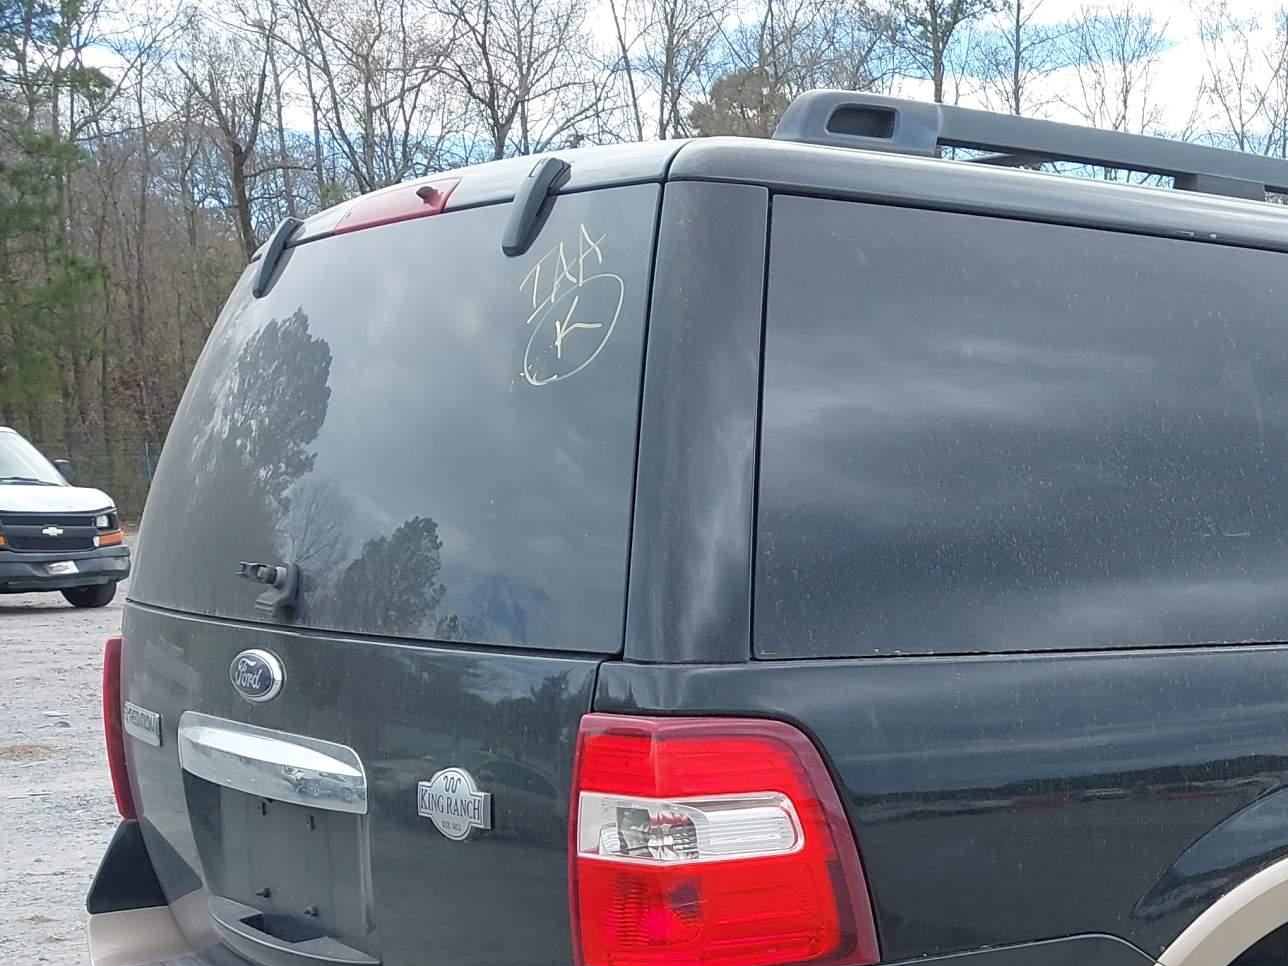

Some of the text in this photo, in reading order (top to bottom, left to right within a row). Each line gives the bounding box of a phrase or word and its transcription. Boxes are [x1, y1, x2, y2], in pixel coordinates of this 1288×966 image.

[554, 295, 602, 359] K
[235, 658, 262, 689] Ford
[420, 788, 481, 821] KING RANCH
